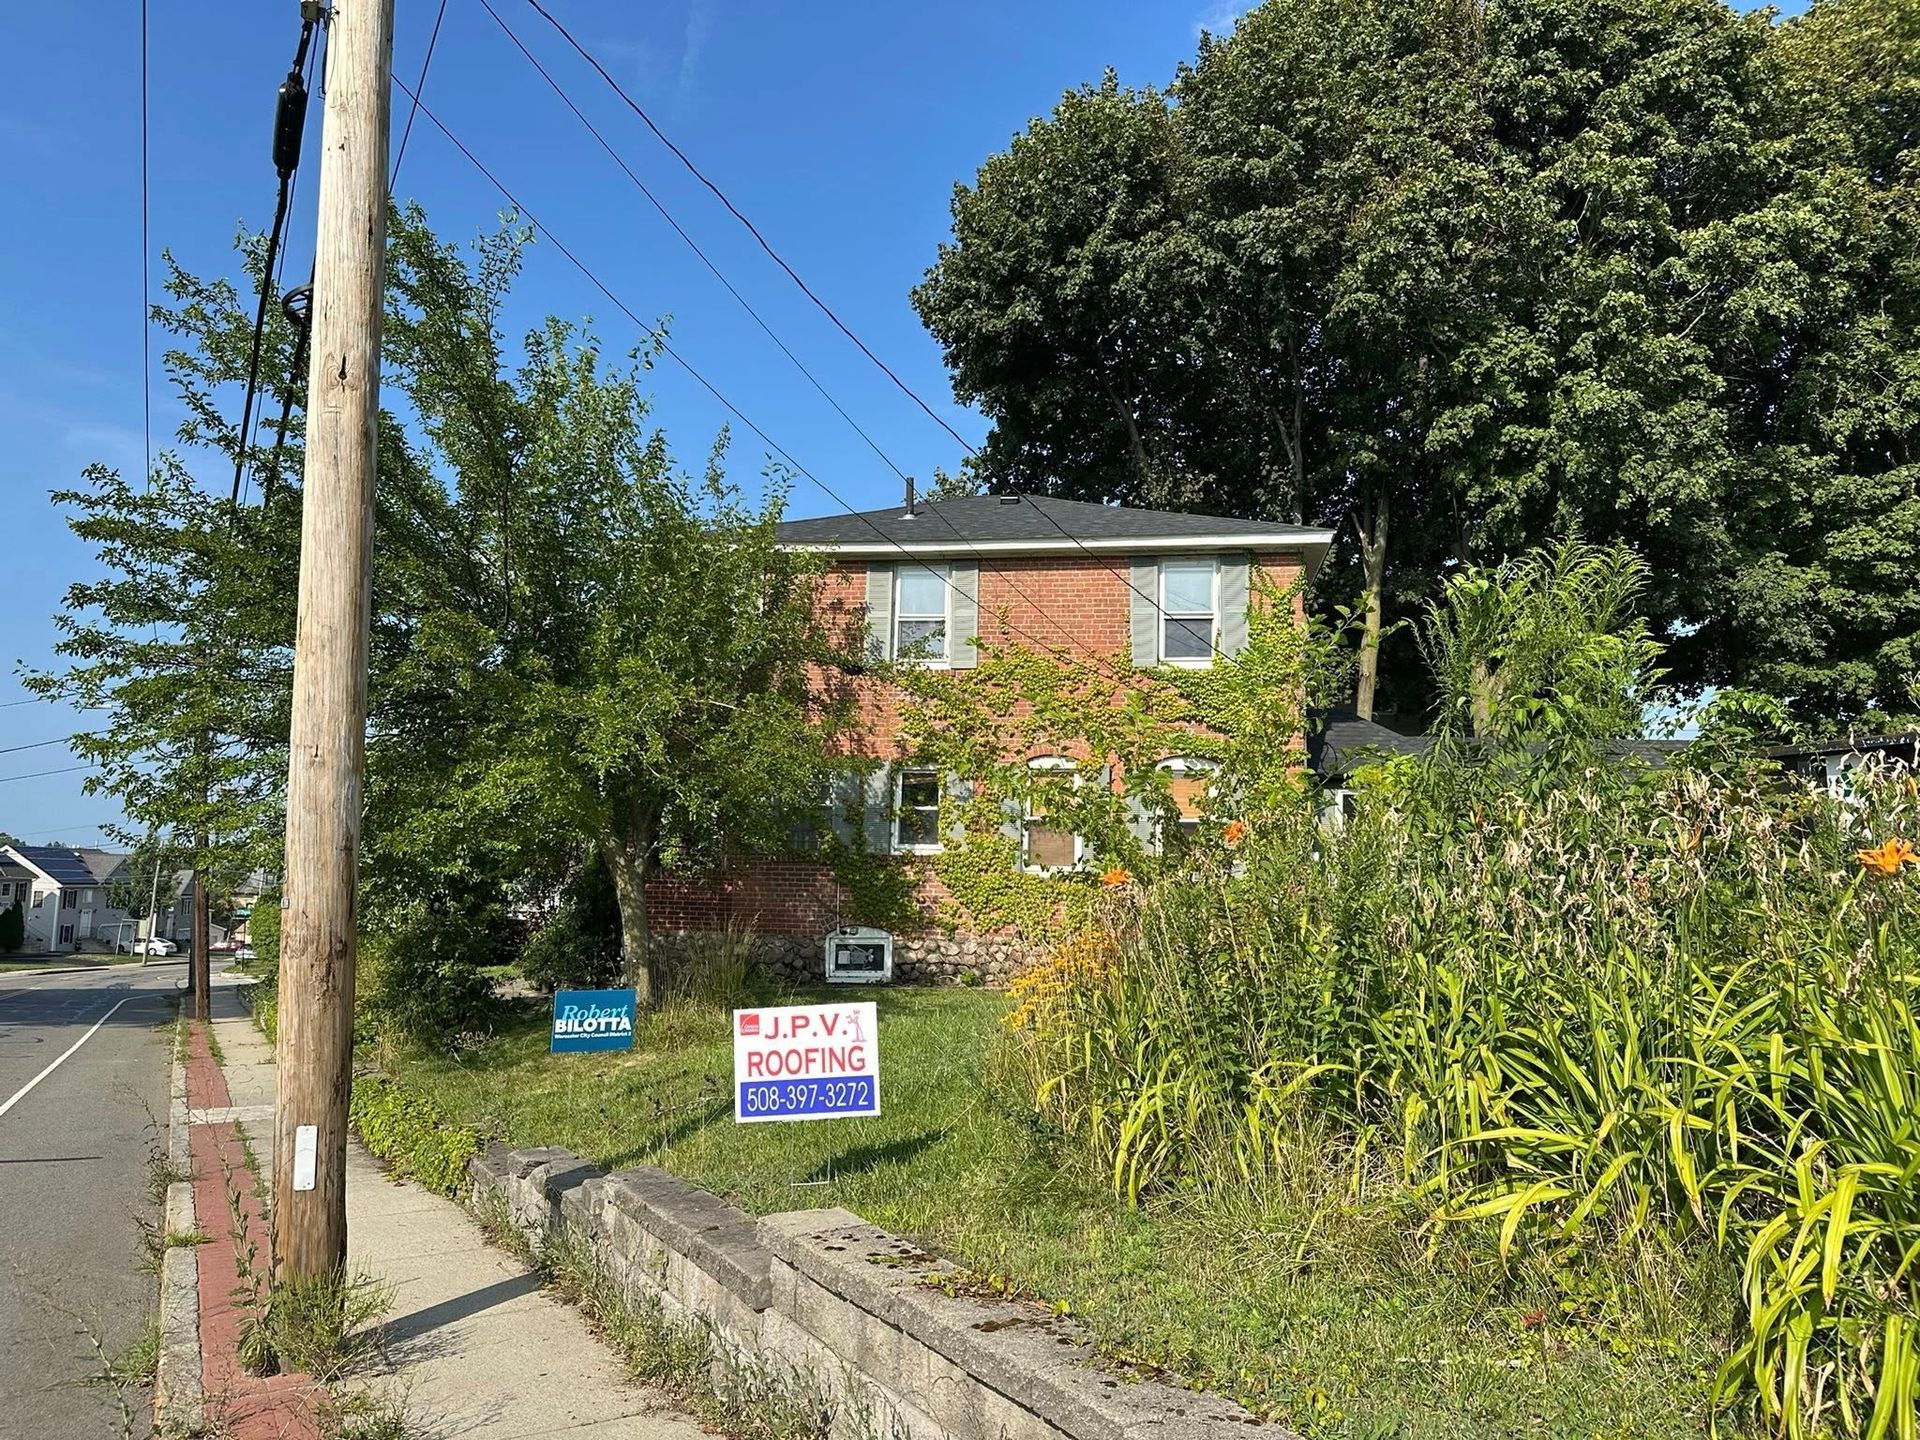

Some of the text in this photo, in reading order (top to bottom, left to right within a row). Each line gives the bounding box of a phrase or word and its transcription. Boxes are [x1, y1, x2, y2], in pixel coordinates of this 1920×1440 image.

[555, 1017, 632, 1033] BILOTTA
[563, 1003, 628, 1021] Robert
[765, 1013, 848, 1040] J.P.V.
[747, 1045, 866, 1077] ROOFING
[747, 1081, 869, 1112] 508-397-3272
